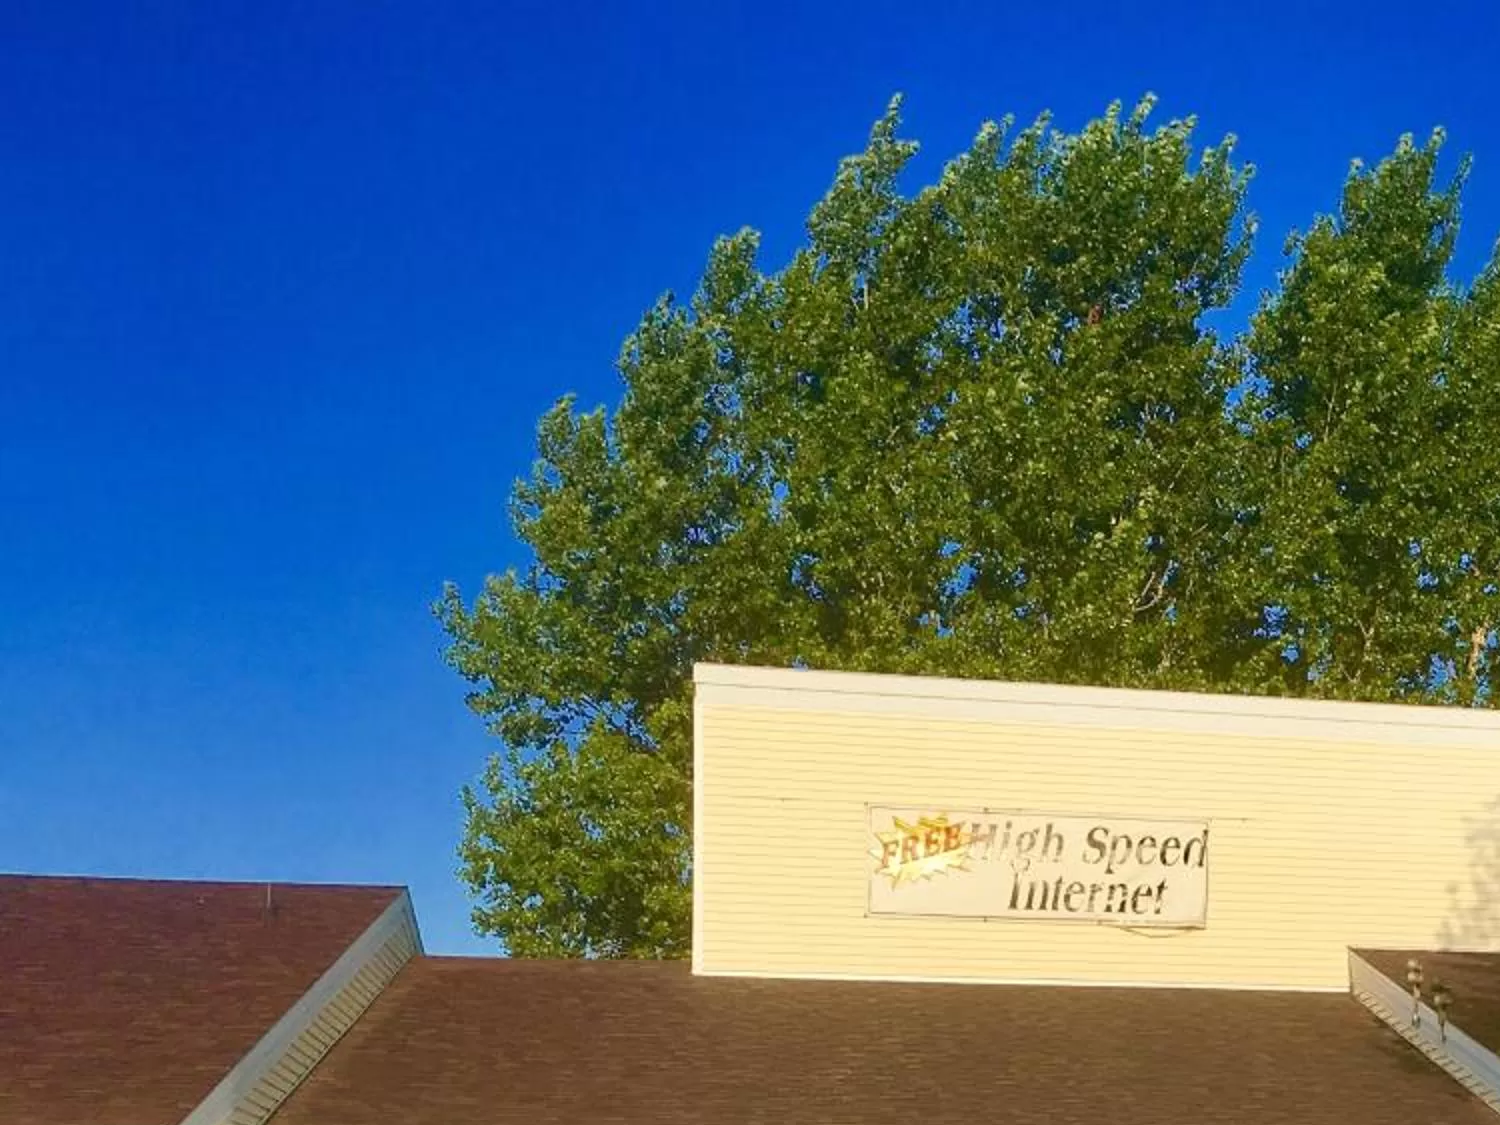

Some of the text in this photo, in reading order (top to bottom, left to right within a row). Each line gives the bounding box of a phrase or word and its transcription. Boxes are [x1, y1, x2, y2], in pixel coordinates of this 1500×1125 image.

[879, 821, 1209, 874] FREE High Speed
[1007, 872, 1168, 915] Internet
